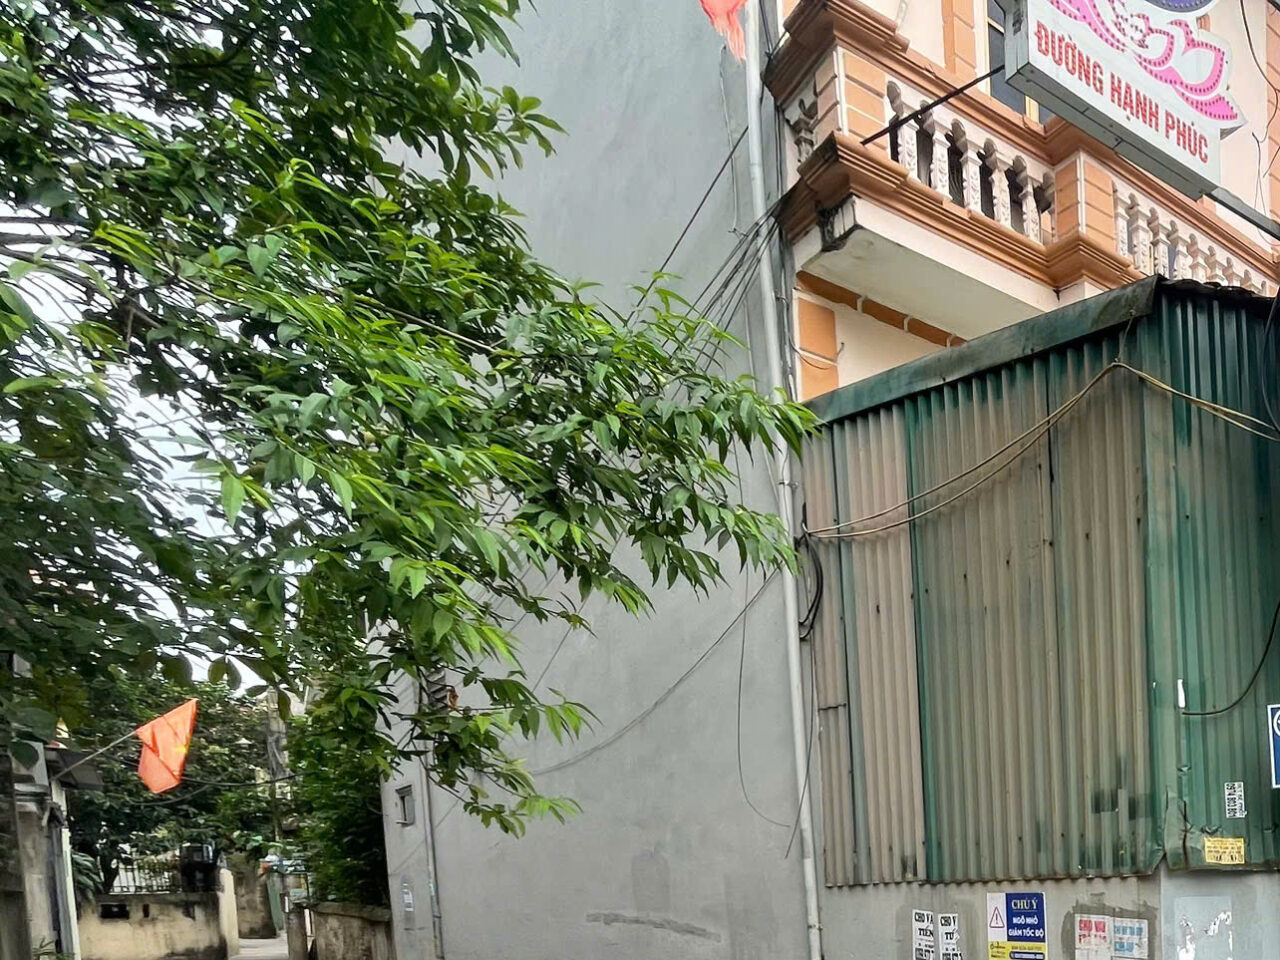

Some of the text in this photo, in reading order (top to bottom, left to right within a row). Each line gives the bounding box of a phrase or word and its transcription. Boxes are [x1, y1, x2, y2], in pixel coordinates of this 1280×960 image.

[1033, 20, 1209, 164] ĐƯỜNG HẠNH PHÚC
[1011, 896, 1038, 910] CHÚ Ý
